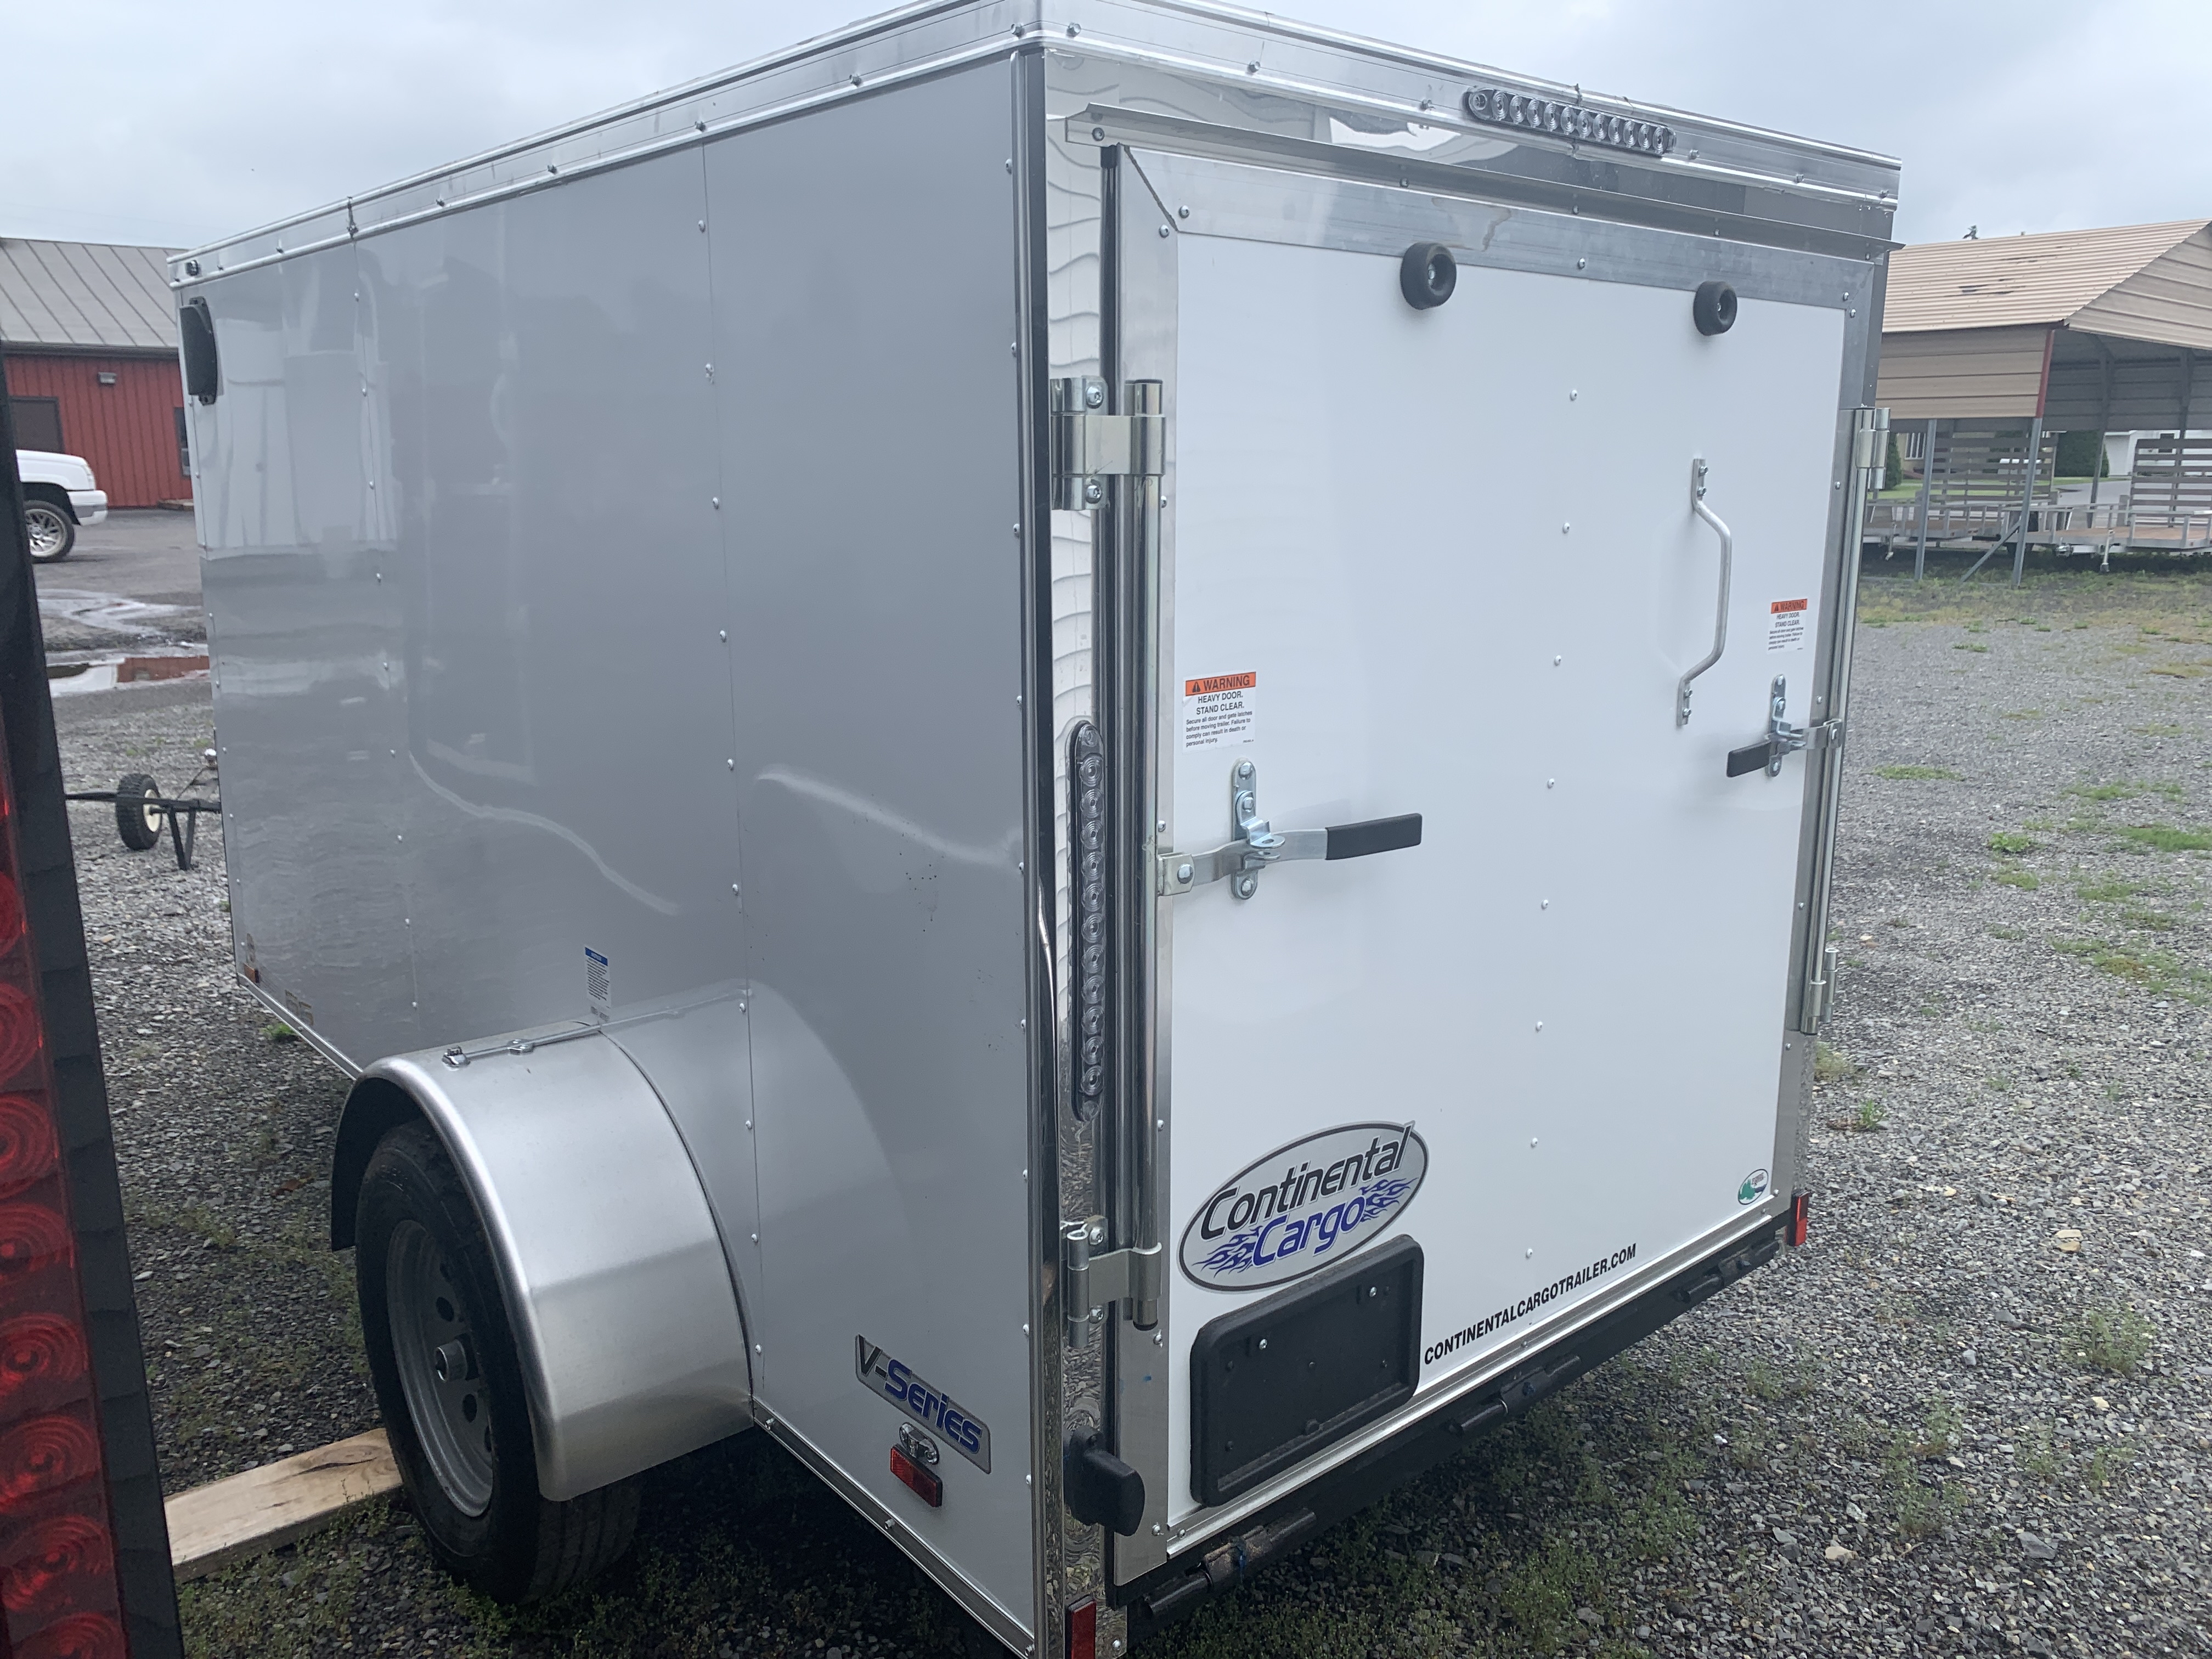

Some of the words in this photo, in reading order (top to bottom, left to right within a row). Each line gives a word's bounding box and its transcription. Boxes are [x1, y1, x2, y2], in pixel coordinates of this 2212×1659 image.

[1780, 601, 1804, 610] WARNING
[1204, 675, 1250, 691] WARNING
[1198, 693, 1220, 703] HEAVY
[1222, 691, 1243, 700] DOOR.
[1196, 705, 1218, 715] STAND
[1220, 701, 1244, 711] CLEAR.
[1186, 739, 1204, 748] personal
[1200, 1125, 1412, 1240] Continental
[1252, 1195, 1367, 1265] Cargo
[1424, 1243, 1637, 1365] CONTINENTALCARGOTRAILER.COM
[858, 1334, 983, 1454] V-Series
